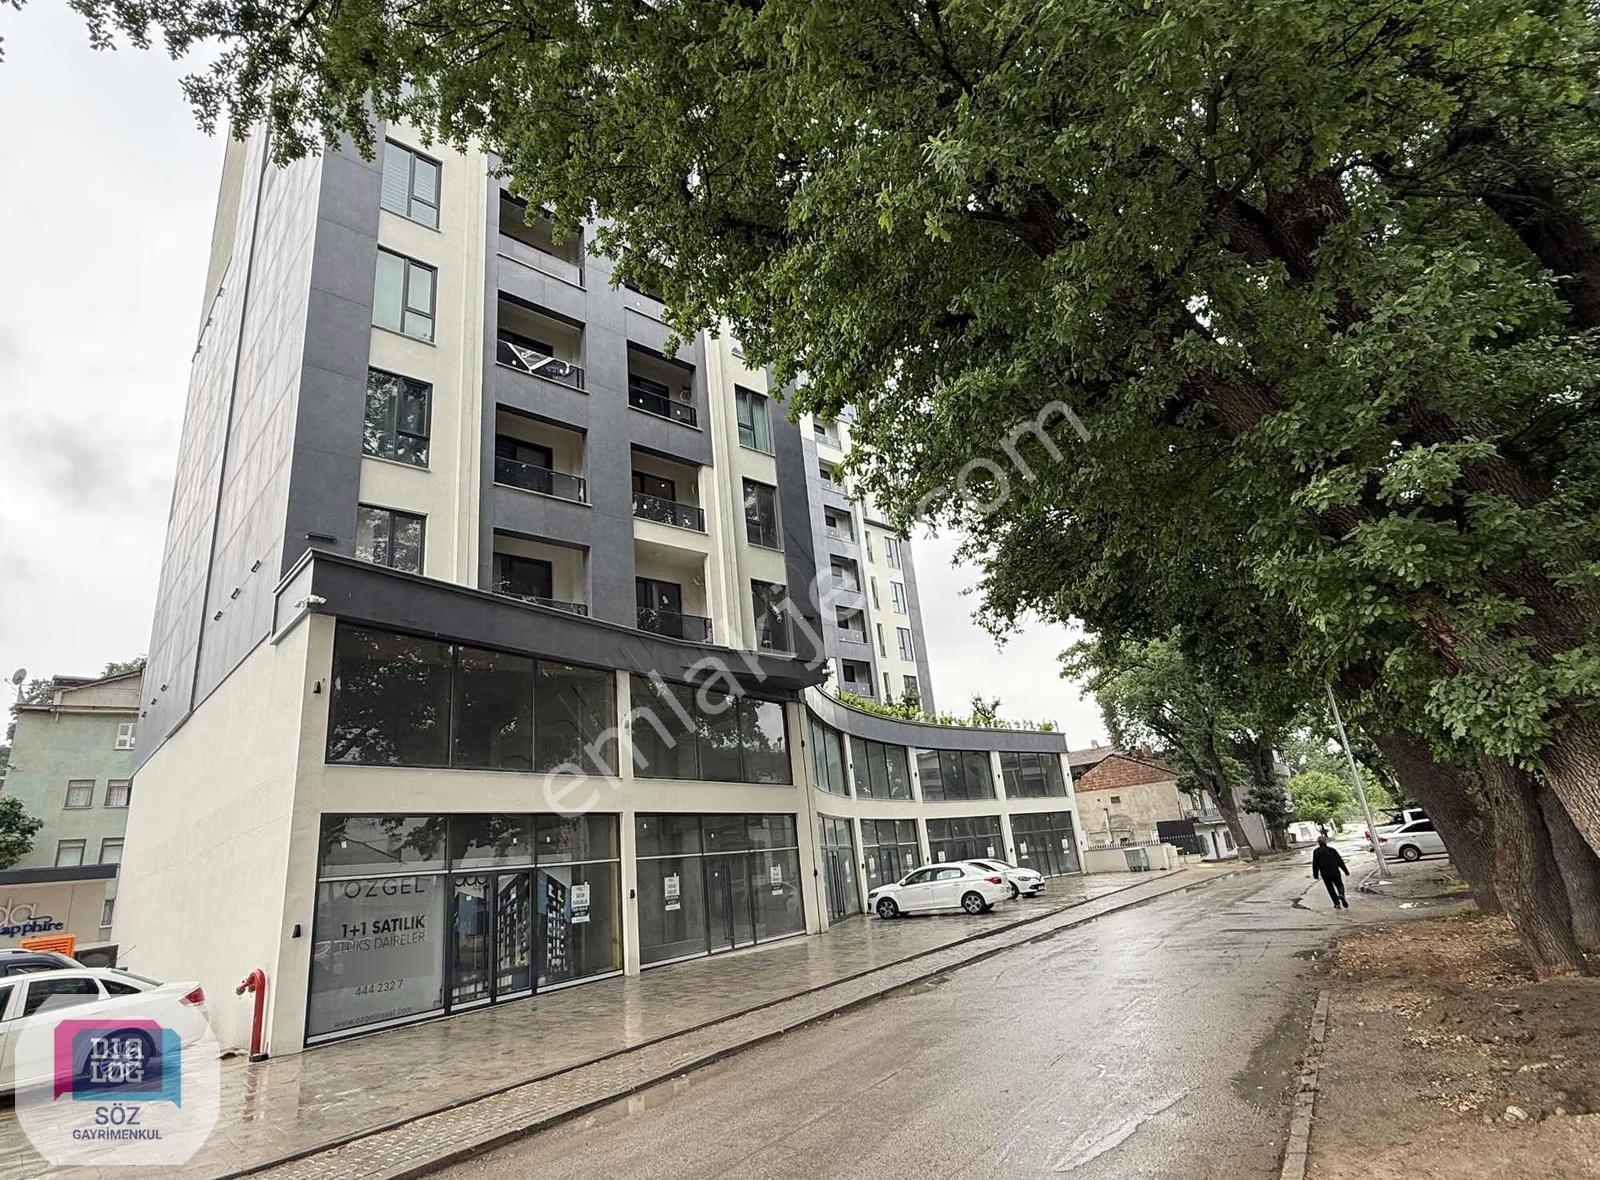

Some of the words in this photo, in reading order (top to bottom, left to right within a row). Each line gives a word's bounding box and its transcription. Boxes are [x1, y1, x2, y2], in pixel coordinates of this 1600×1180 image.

[341, 922, 367, 938] 1+1
[372, 915, 425, 934] SATILIK
[355, 984, 375, 996] 444
[377, 980, 396, 993] 232
